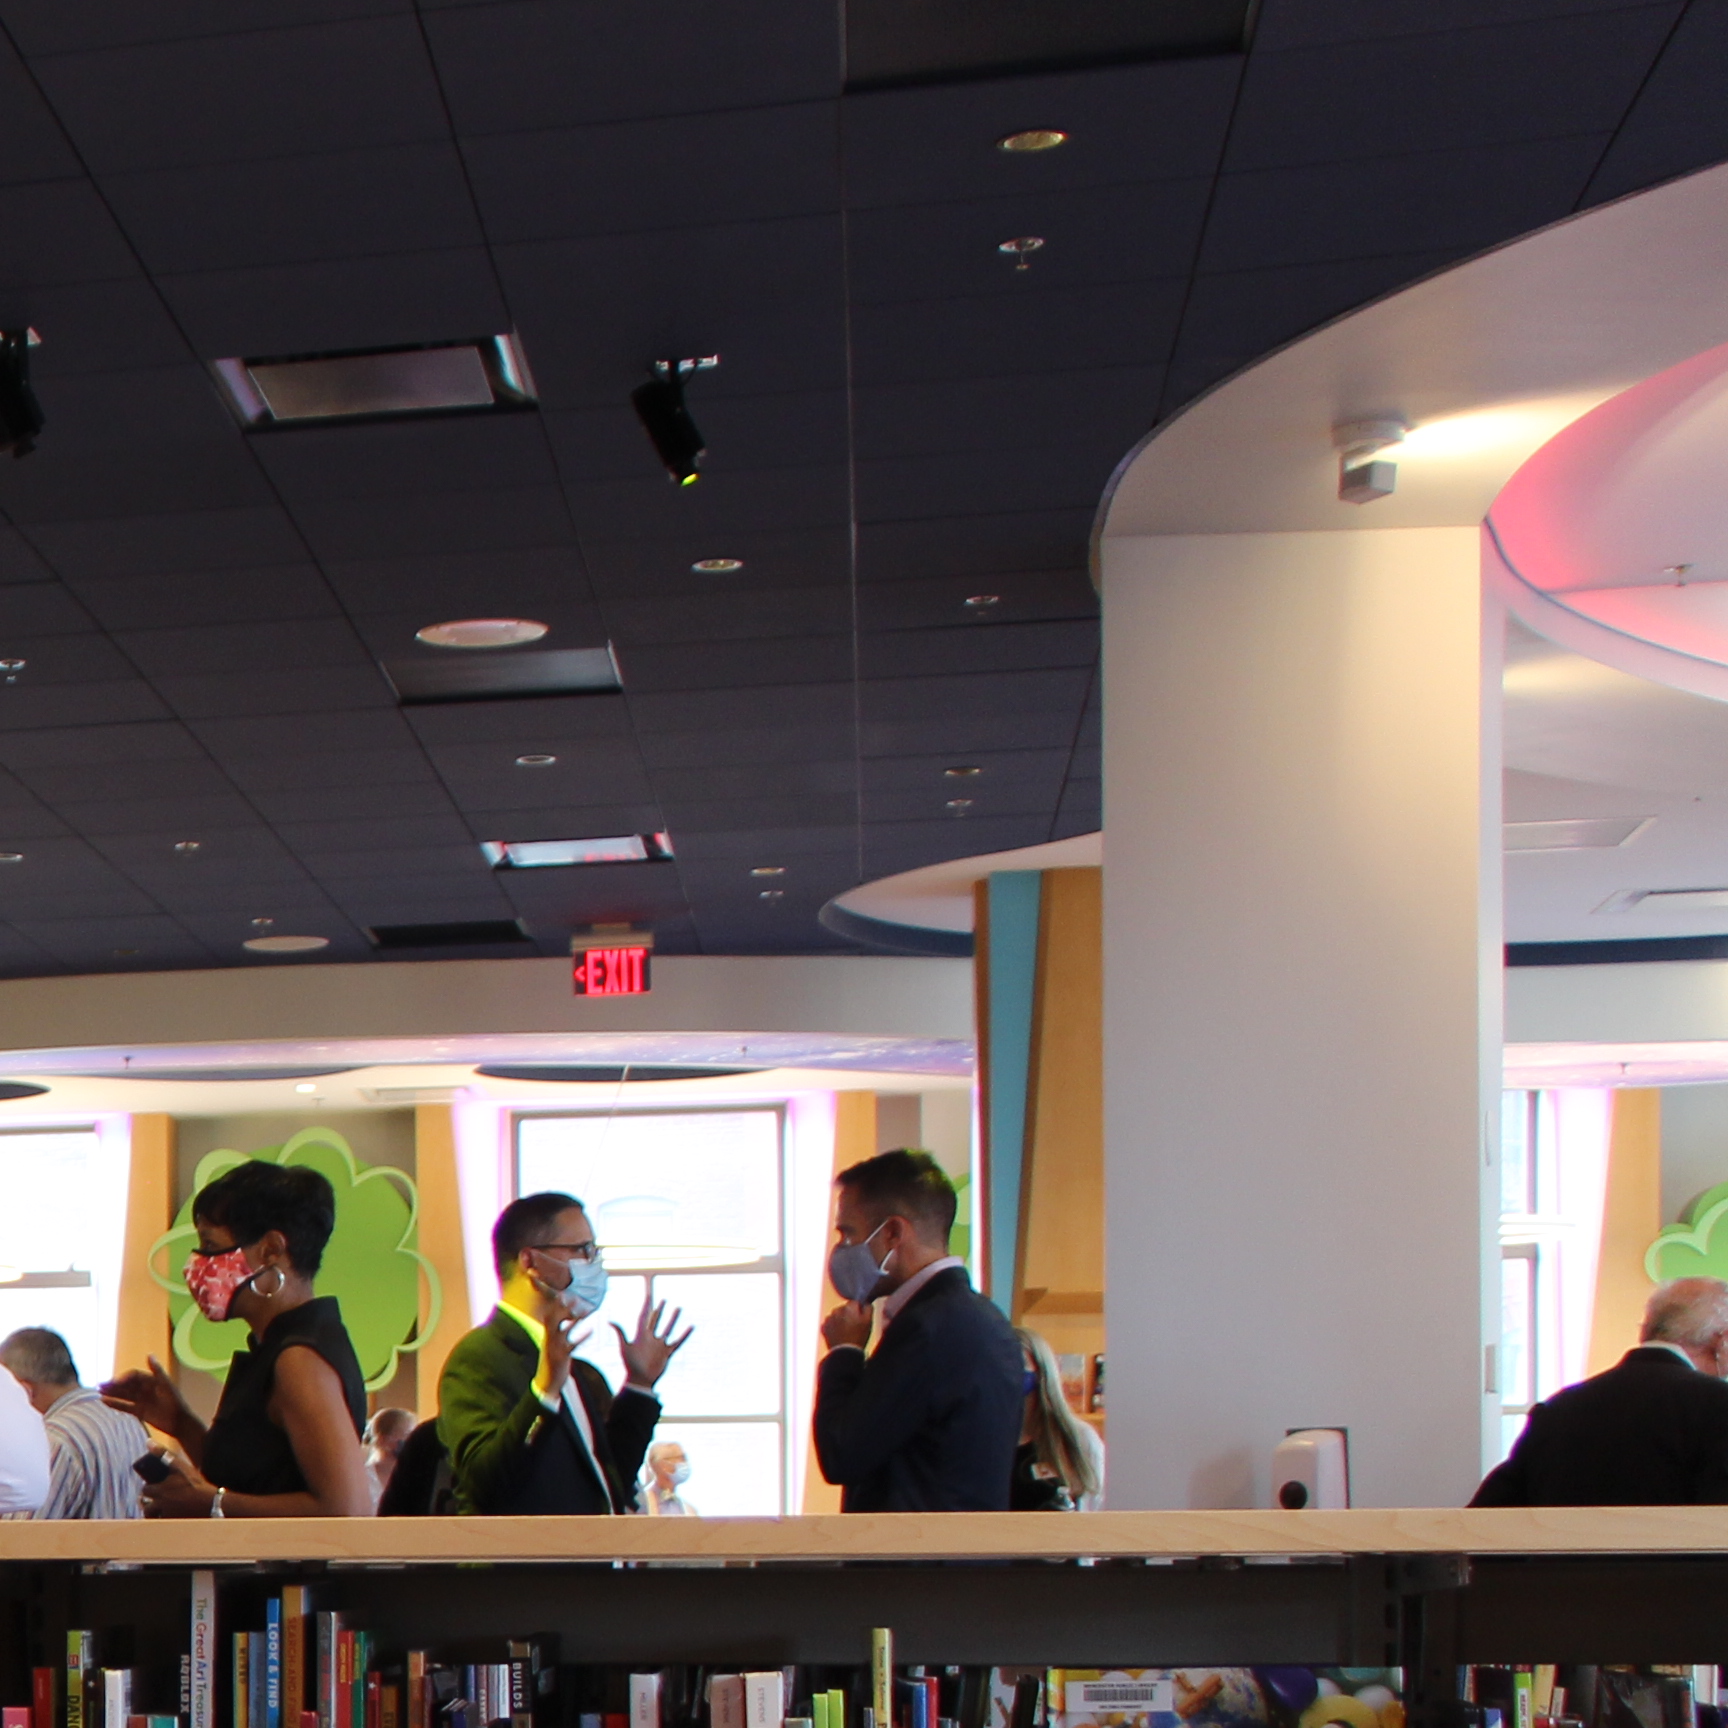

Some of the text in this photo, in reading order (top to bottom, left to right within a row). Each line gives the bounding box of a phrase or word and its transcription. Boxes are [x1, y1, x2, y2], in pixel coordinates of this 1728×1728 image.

[585, 947, 646, 995] EXIT
[196, 1597, 207, 1620] The
[196, 1622, 207, 1658] Great
[196, 1660, 207, 1681] Art
[268, 1623, 279, 1708] LOOK FIND
[512, 1662, 522, 1709] BUILDS
